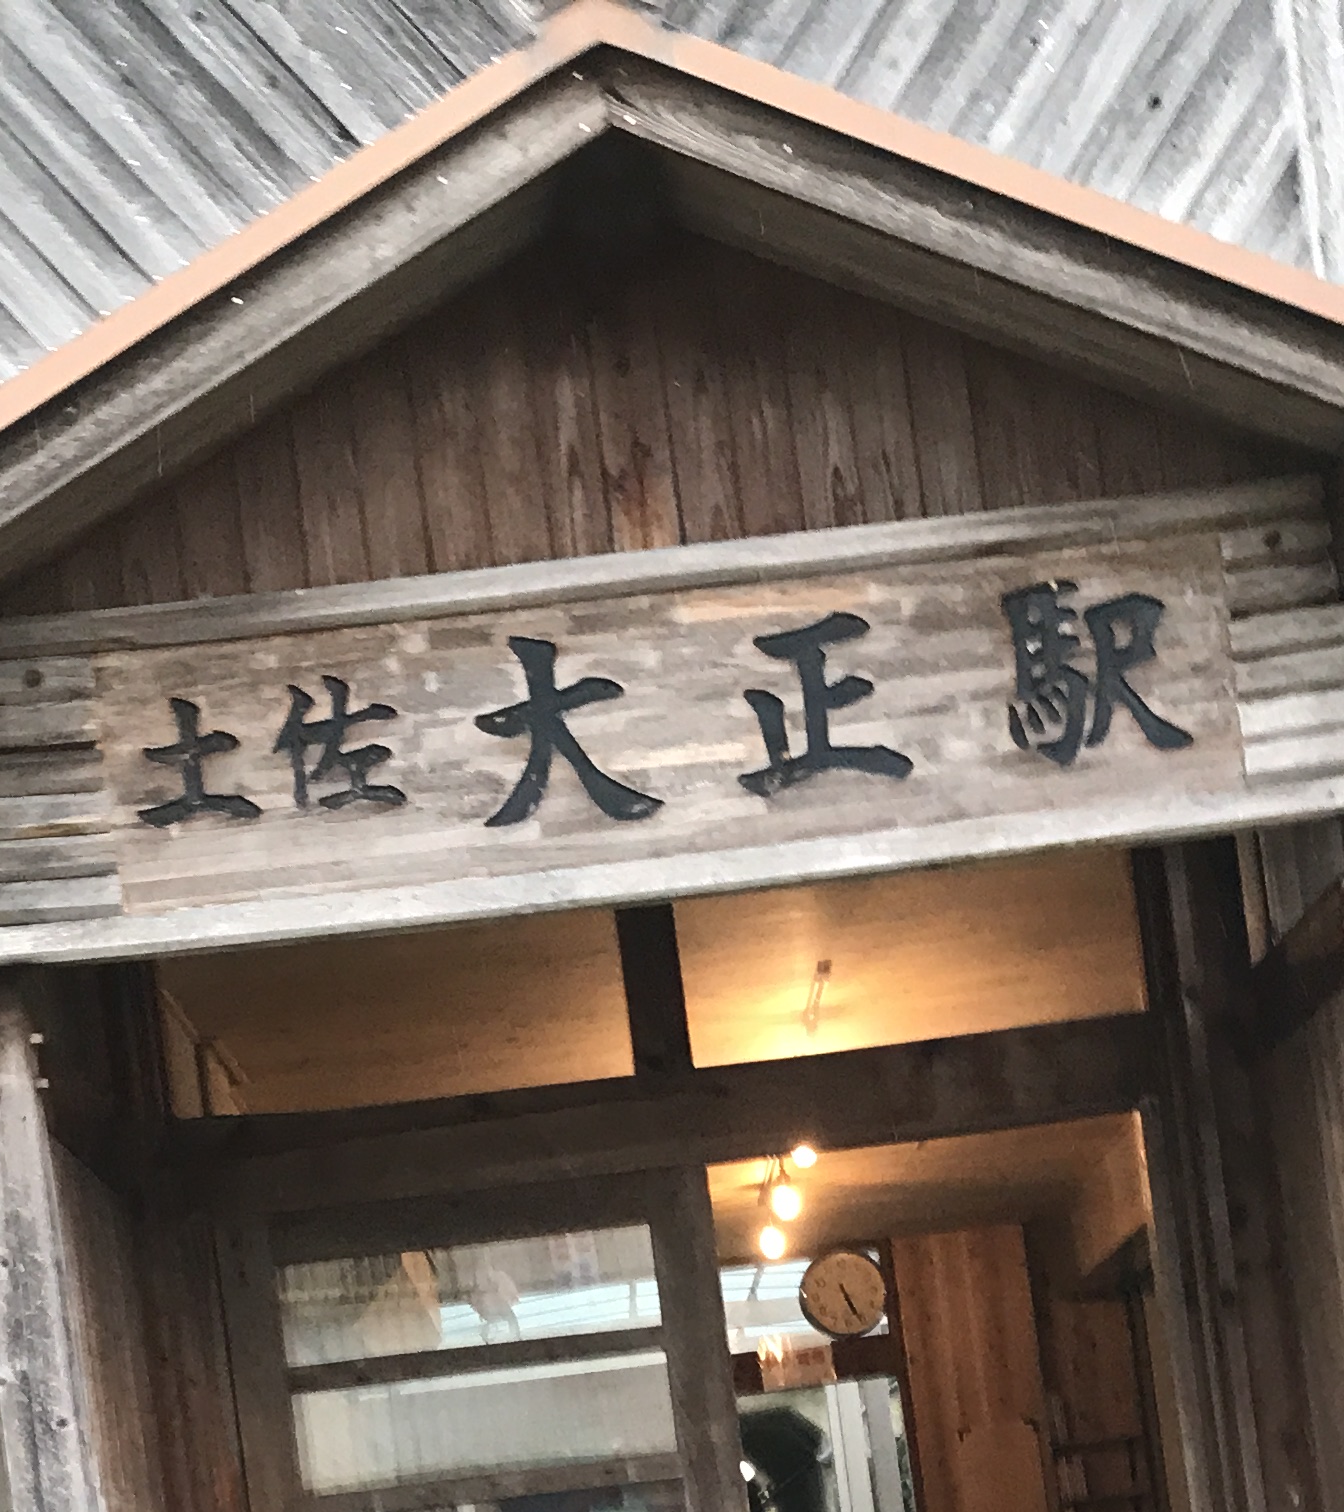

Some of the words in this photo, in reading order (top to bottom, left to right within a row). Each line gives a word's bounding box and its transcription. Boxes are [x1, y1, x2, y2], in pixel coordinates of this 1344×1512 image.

[136, 579, 1196, 829] 土佐大正駅
